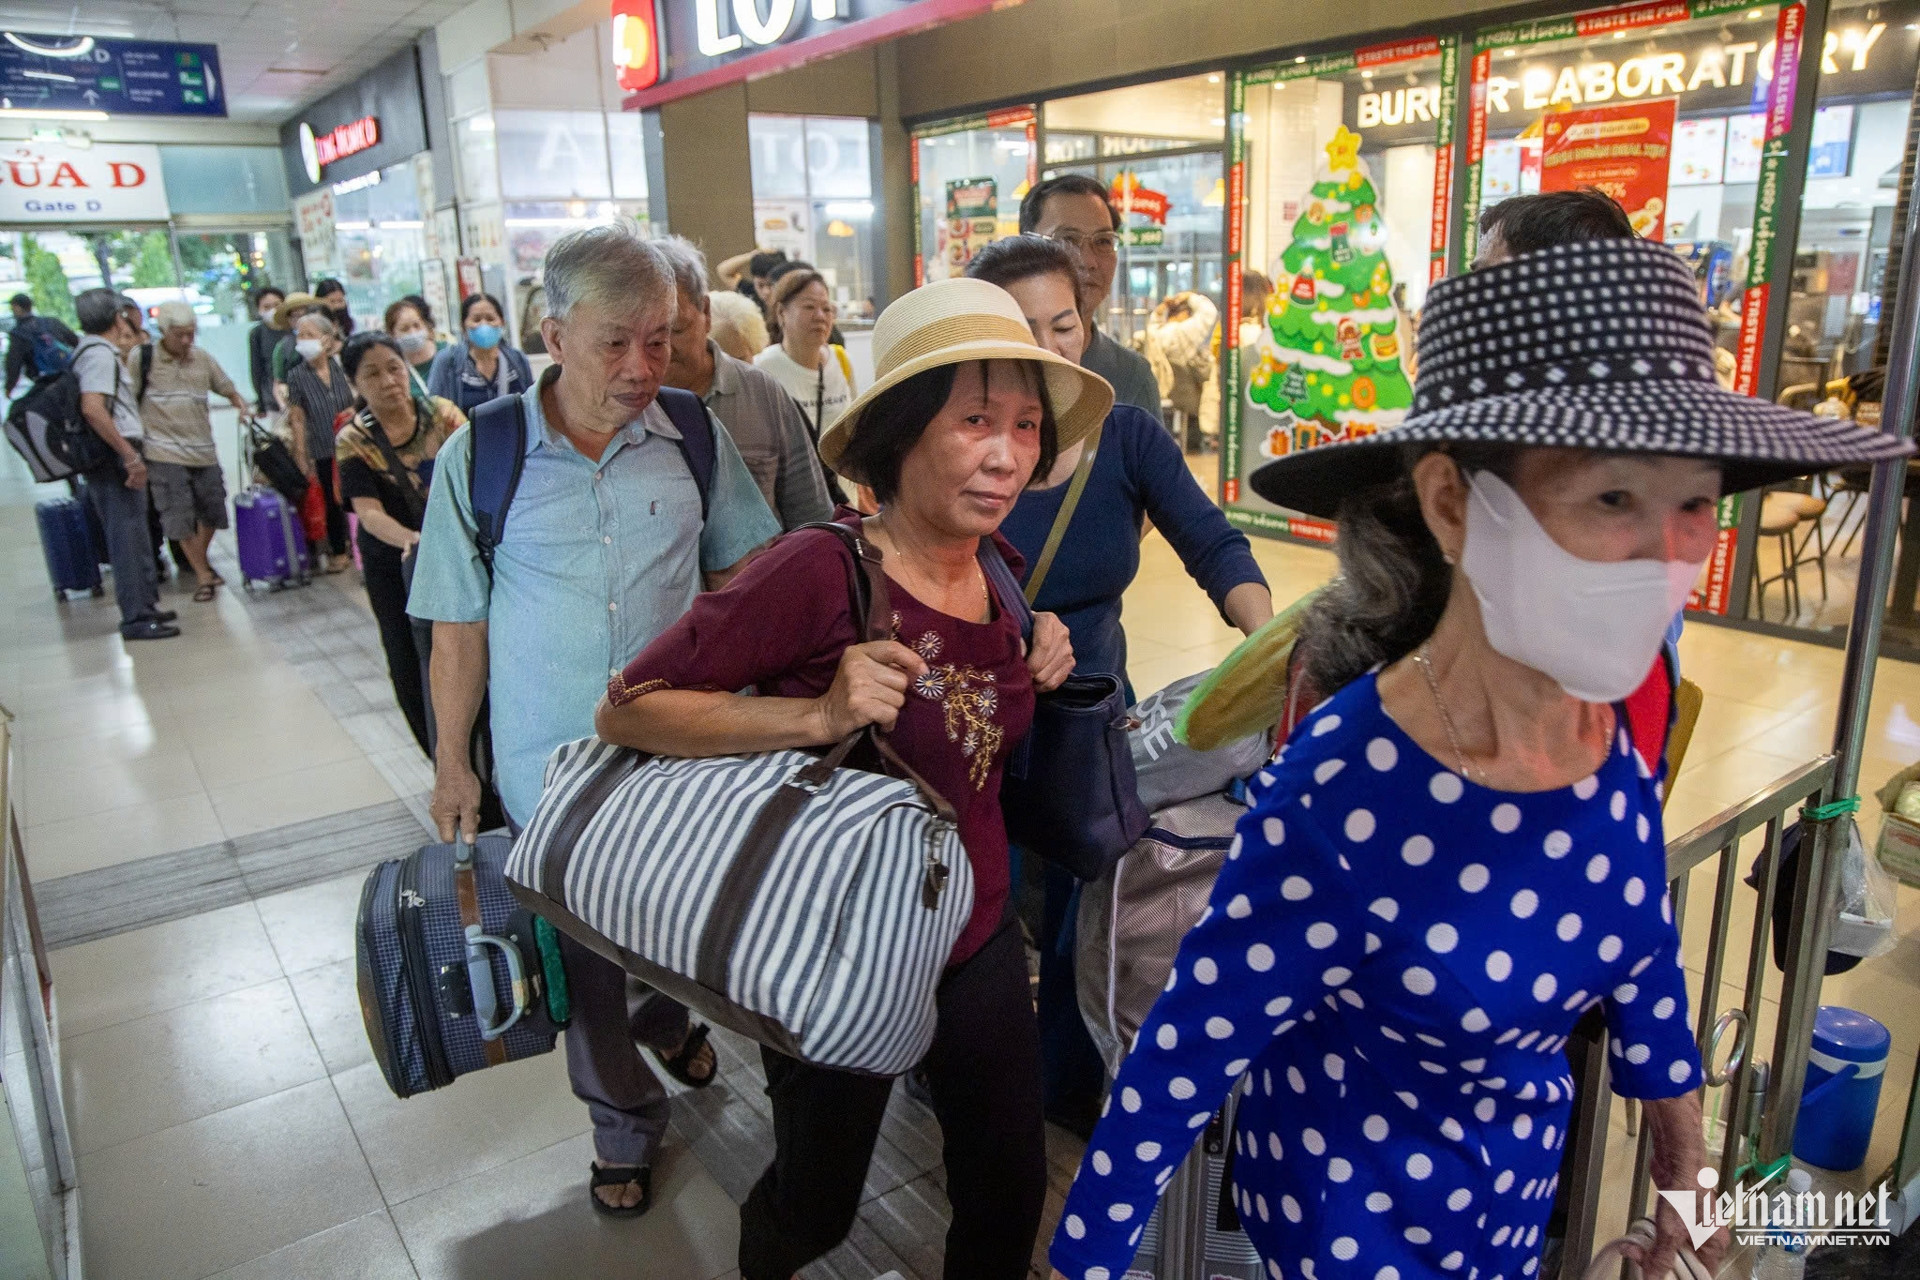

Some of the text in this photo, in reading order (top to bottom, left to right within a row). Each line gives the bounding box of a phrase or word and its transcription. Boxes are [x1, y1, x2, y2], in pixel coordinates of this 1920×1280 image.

[696, 0, 836, 56] LO
[1773, 8, 1799, 123] TASTE THE FUN
[0, 149, 147, 188] ỬA D
[25, 200, 102, 213] Gate D
[1743, 299, 1760, 344] TASTE
[1740, 345, 1756, 372] THE
